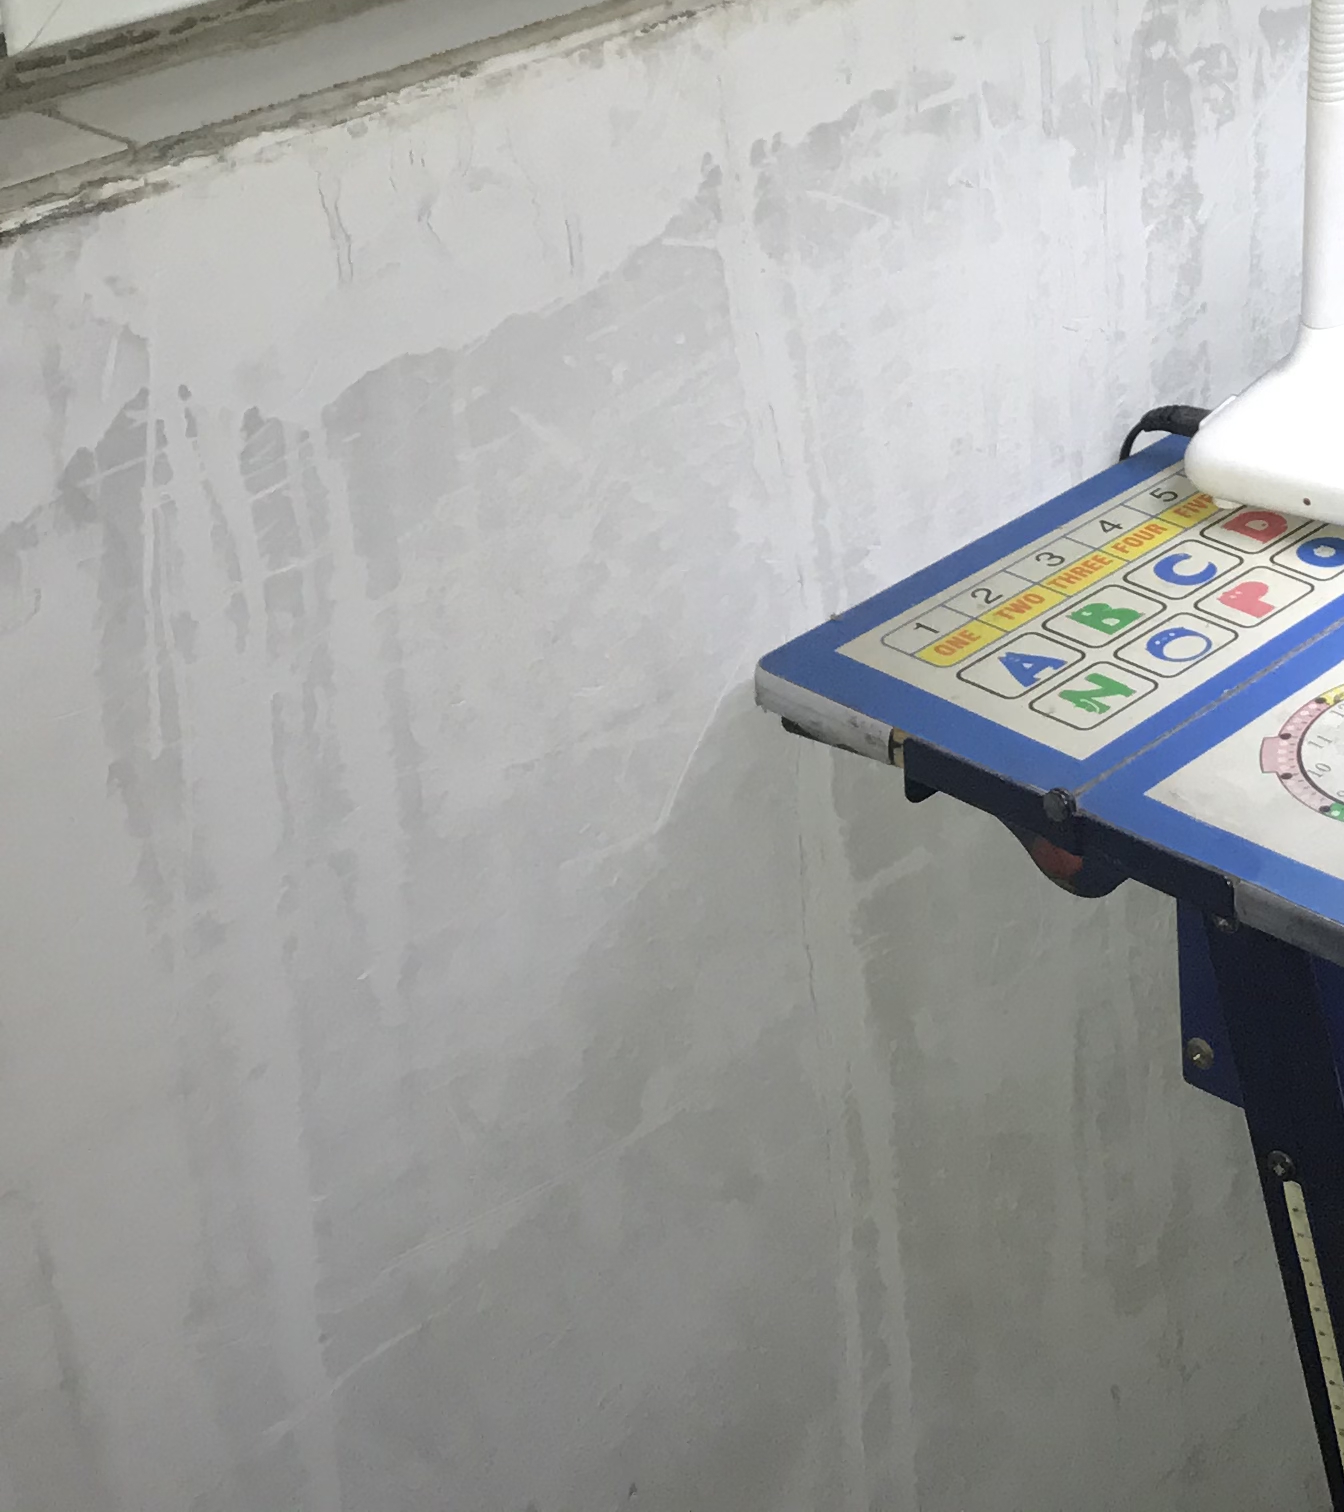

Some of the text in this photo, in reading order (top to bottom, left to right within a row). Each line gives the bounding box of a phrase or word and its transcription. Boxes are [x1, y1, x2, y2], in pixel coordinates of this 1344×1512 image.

[1150, 486, 1180, 504] 5
[1171, 491, 1214, 521] FIVE
[1098, 519, 1125, 535] 4
[1113, 523, 1168, 557] FOUR
[1222, 510, 1290, 545] D
[1034, 550, 1066, 568] 3
[1048, 553, 1114, 591] THREE
[1153, 551, 1219, 587] C
[970, 586, 1005, 608] 2
[993, 591, 1046, 623] TWO
[1217, 580, 1277, 620] P
[912, 619, 941, 637] 1
[1067, 601, 1146, 637] B
[932, 627, 982, 659] ONE
[1146, 625, 1214, 664] O
[997, 651, 1070, 689] A
[1058, 672, 1138, 716] N
[1308, 734, 1333, 751] 11
[1308, 762, 1333, 779] 10
